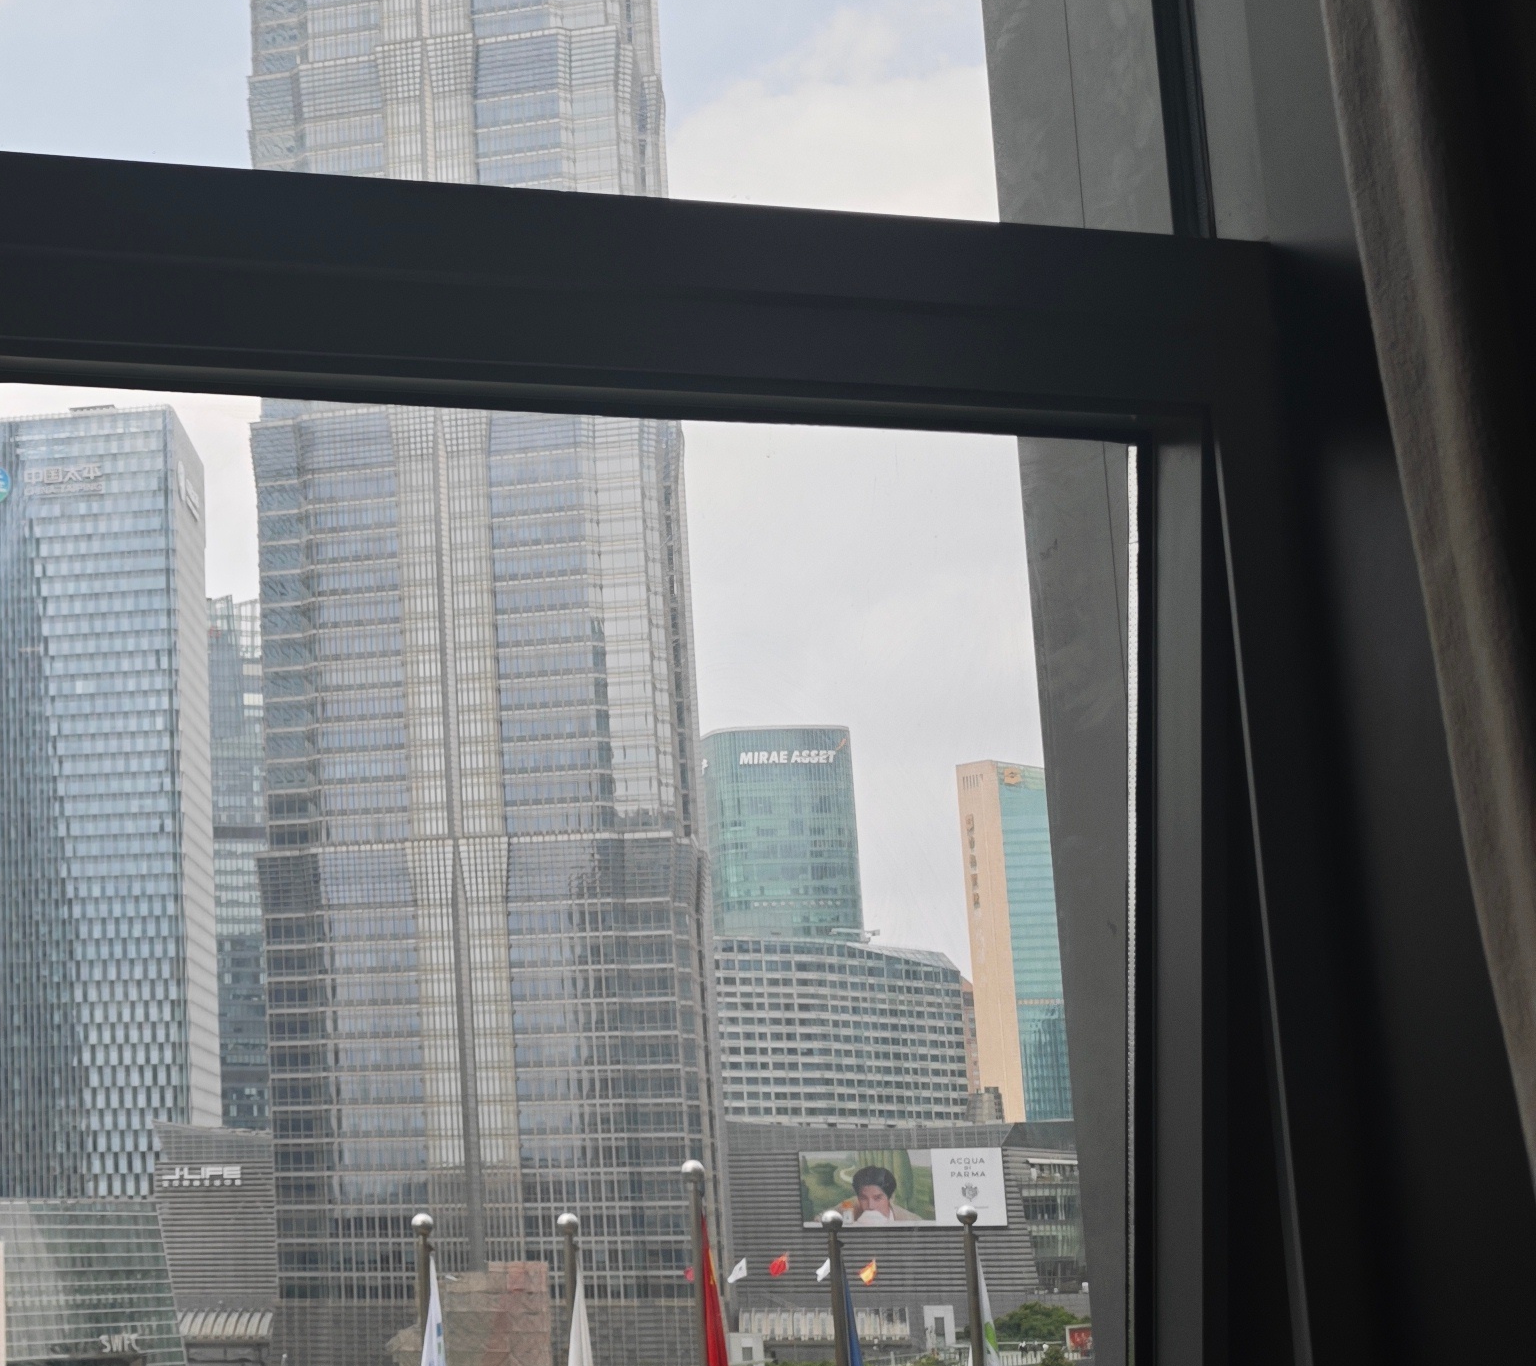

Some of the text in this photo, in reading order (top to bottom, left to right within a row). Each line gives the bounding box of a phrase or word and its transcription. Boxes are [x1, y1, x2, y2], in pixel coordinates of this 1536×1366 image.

[24, 463, 102, 484] 中国太平
[739, 750, 836, 765] MIRAE ASSET
[949, 1157, 985, 1165] ACQUA
[98, 1332, 140, 1353] SWFC
